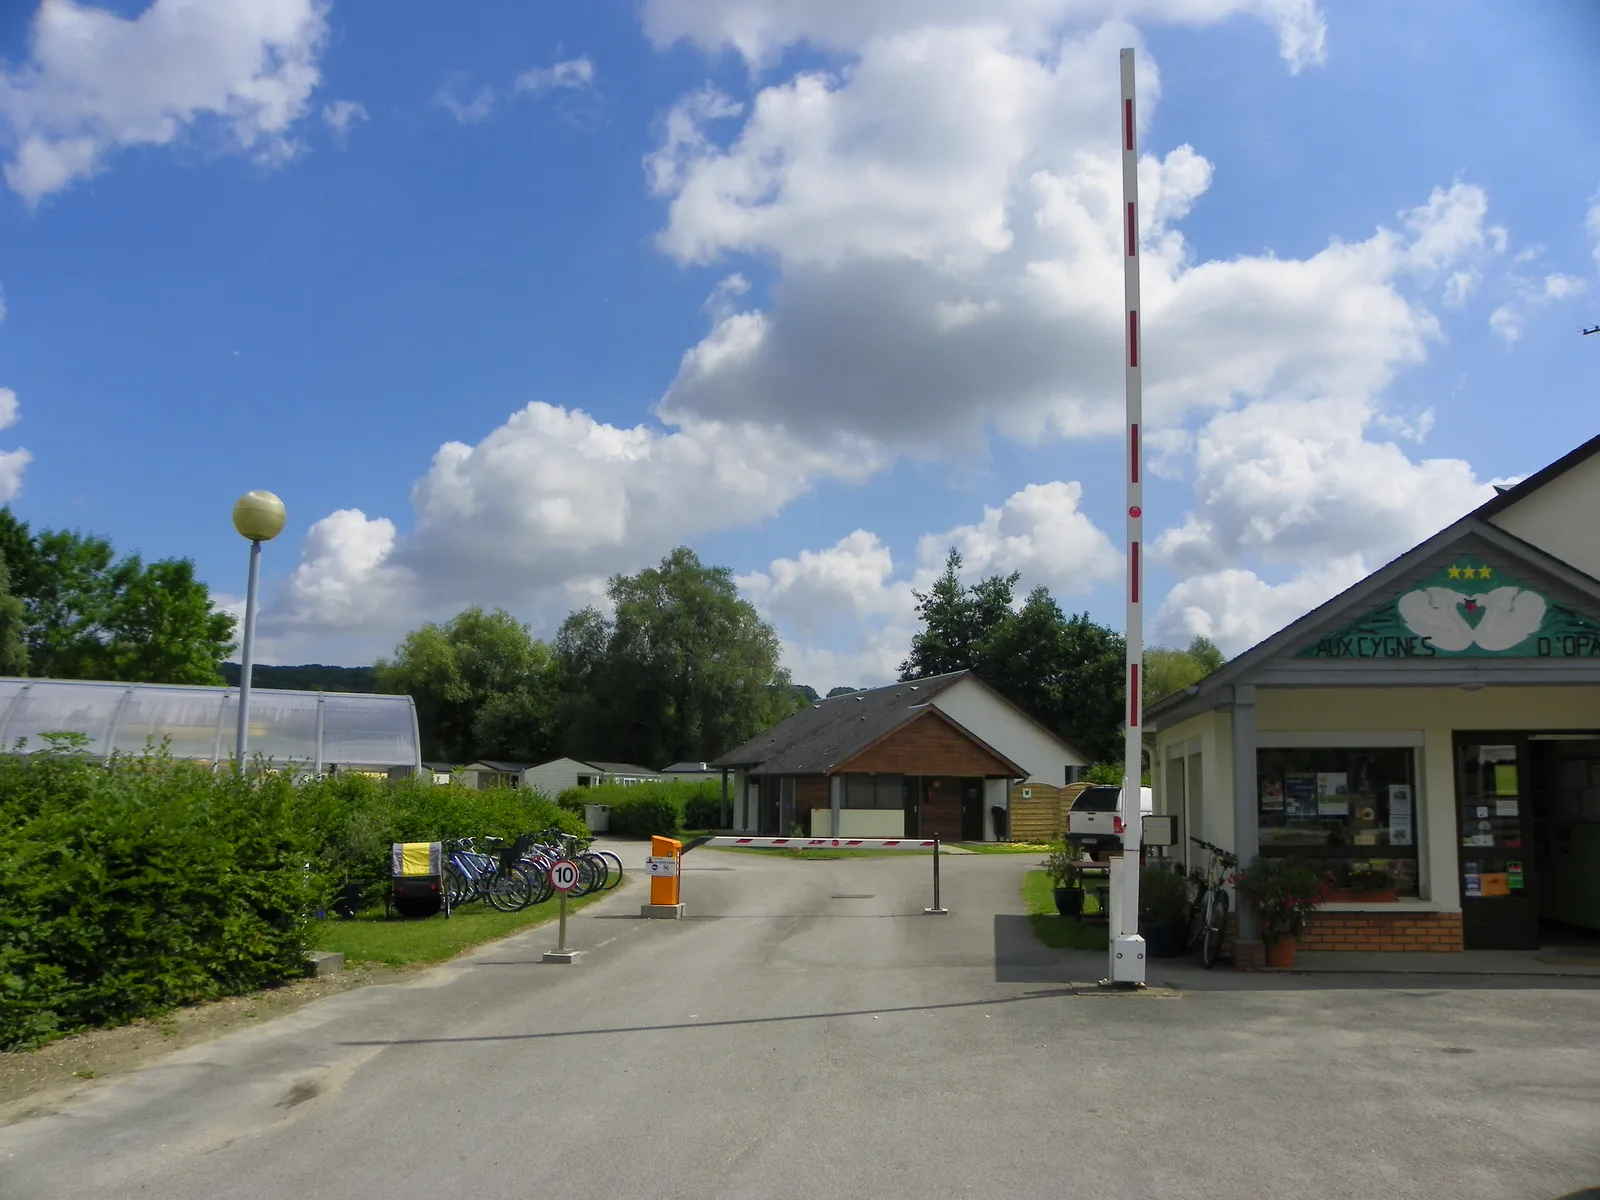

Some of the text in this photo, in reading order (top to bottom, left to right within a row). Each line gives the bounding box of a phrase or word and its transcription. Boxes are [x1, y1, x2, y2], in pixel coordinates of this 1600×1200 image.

[1315, 637, 1354, 658] AUX
[1358, 636, 1437, 658] CYGNES
[555, 866, 574, 883] 10
